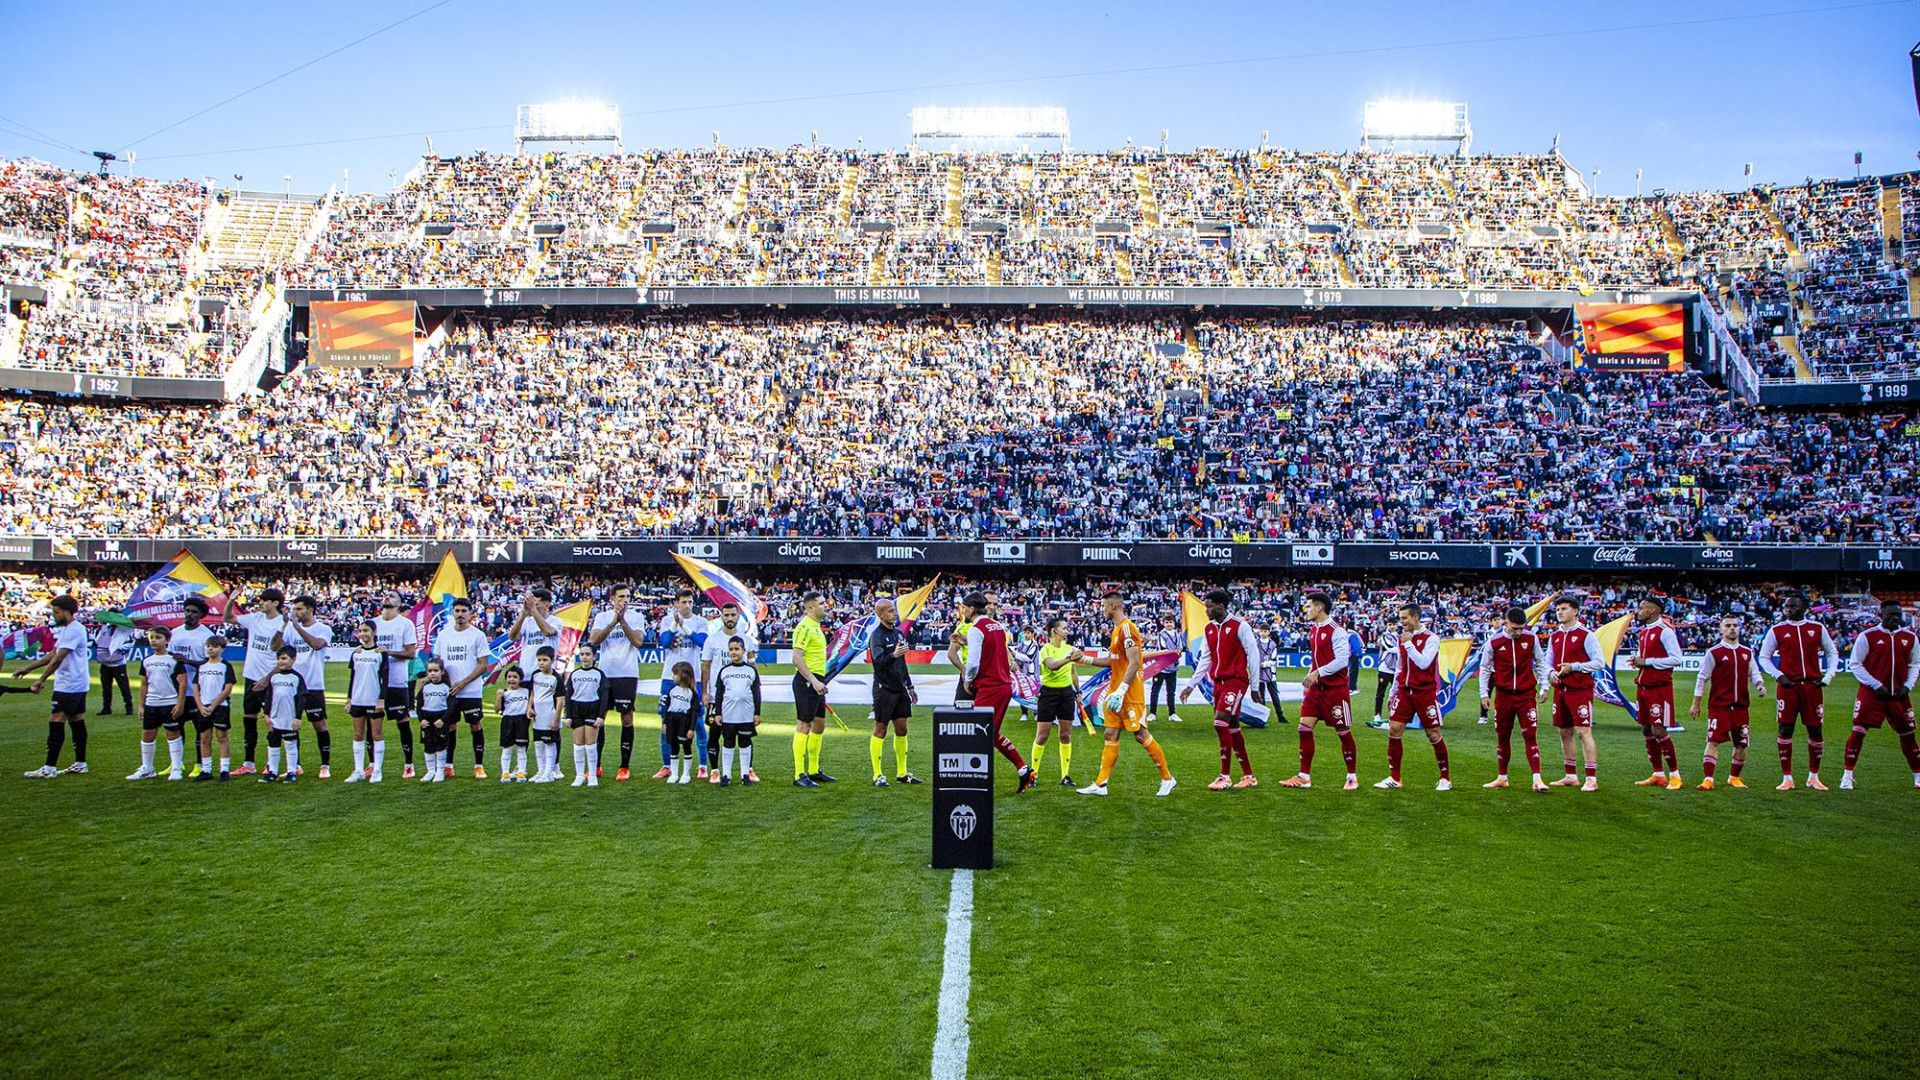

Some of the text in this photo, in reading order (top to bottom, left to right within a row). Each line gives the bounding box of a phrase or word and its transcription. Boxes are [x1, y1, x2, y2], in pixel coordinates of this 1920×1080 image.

[498, 291, 520, 302] 1967
[653, 290, 674, 301] 1971
[834, 289, 920, 300] THIS IS MESTALLA
[1069, 289, 1174, 301] WE THANK OUR FANS!
[1318, 291, 1341, 303] 1979
[90, 378, 119, 392] 1962
[1878, 384, 1908, 398] 1999
[287, 541, 318, 550] divina
[681, 546, 695, 554] TM
[778, 543, 821, 556] divina
[987, 547, 1000, 555] TM
[95, 551, 130, 560] TURIA
[877, 546, 912, 559] PUMA
[1083, 548, 1119, 560] PUMA
[1188, 545, 1231, 558] divina
[1295, 549, 1309, 557] TM
[1702, 548, 1733, 558] divina
[1868, 561, 1903, 570] TURIA
[939, 723, 976, 735] PUMA
[942, 758, 959, 768] TM
